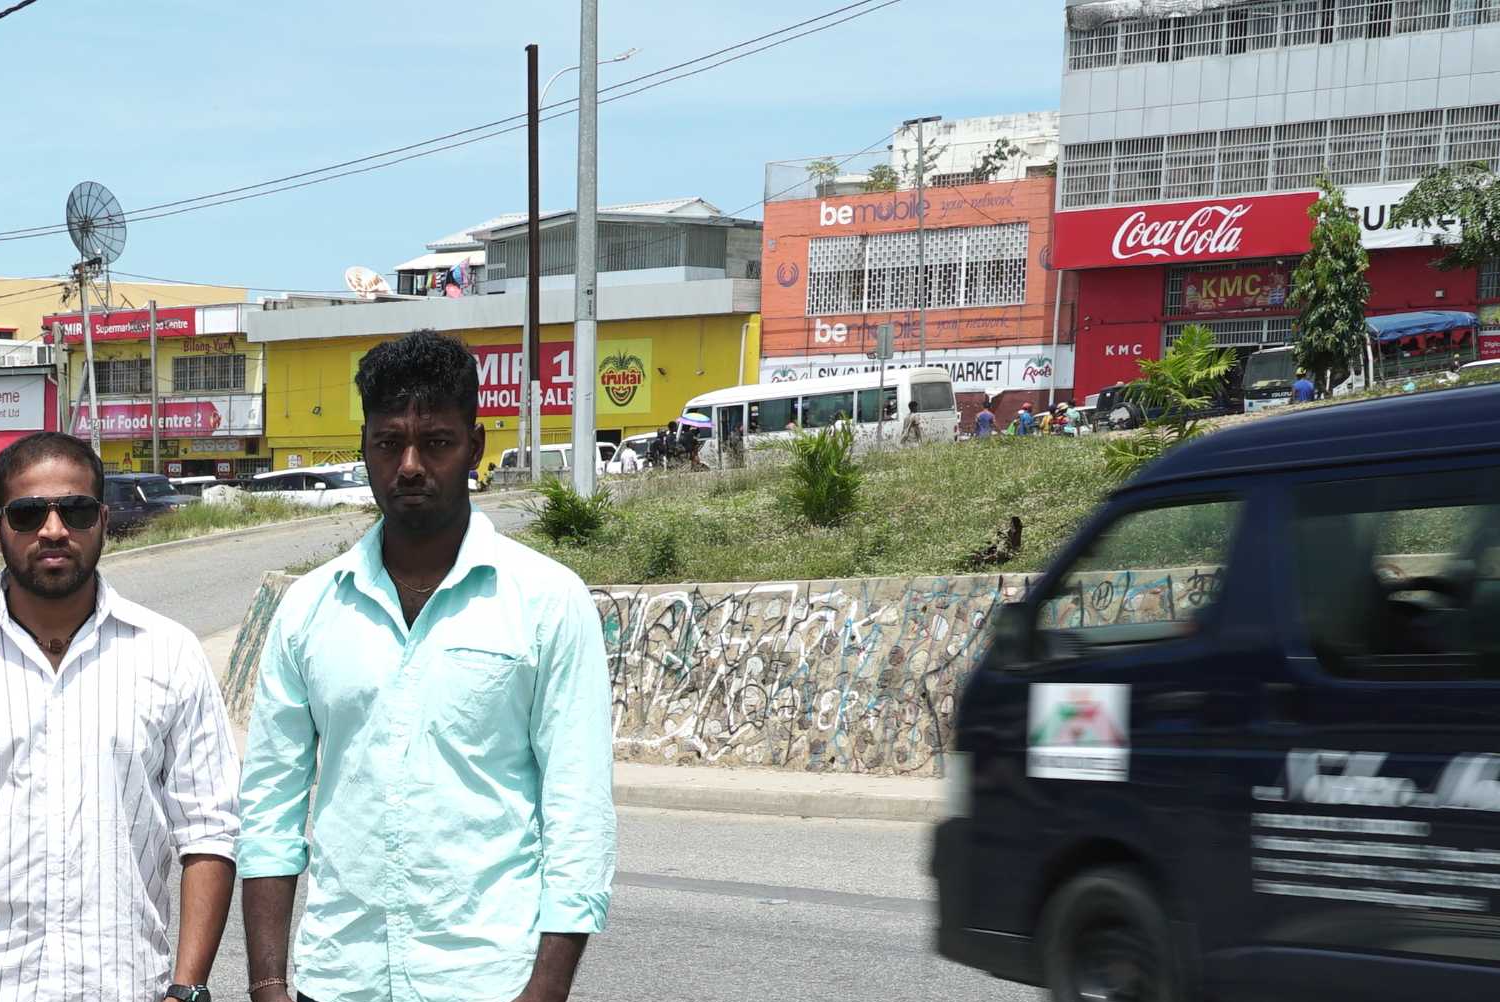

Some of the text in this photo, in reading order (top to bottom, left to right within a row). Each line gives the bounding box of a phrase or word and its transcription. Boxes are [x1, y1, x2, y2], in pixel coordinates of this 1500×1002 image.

[1112, 203, 1252, 260] Coca-Cola
[1202, 274, 1263, 298] KMC
[62, 322, 83, 336] MIR
[552, 350, 574, 384] 1
[8, 409, 20, 418] Ltd
[117, 414, 148, 429] Food
